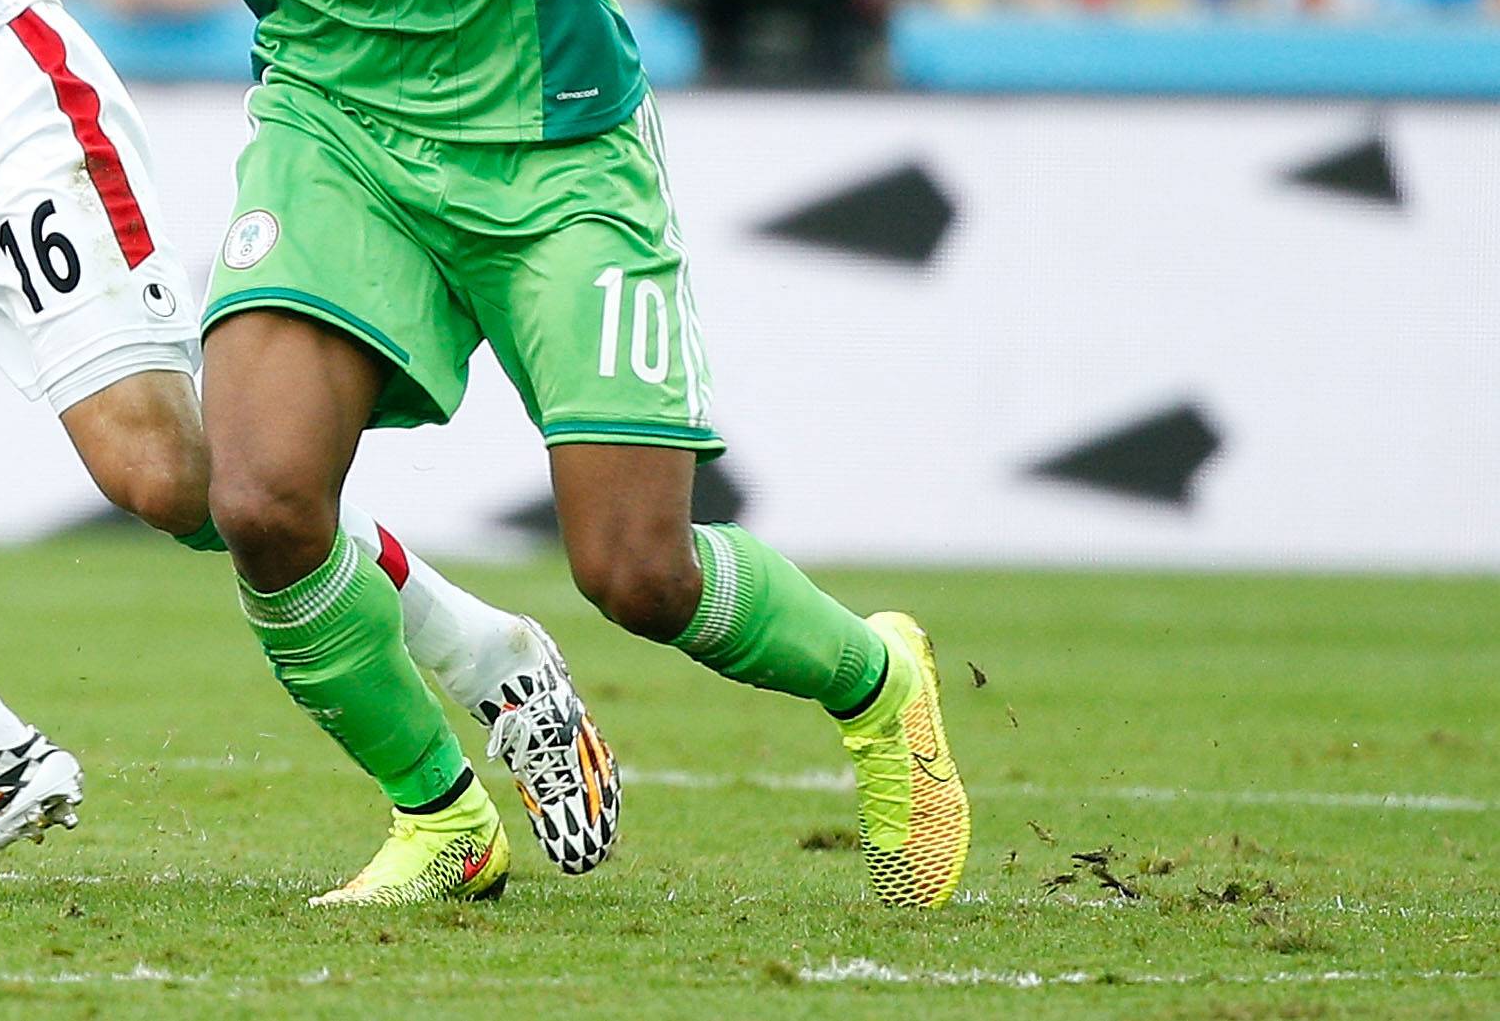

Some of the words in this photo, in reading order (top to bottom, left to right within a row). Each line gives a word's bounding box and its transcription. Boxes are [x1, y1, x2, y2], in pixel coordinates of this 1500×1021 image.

[556, 87, 599, 101] climacool
[0, 198, 81, 314] 16
[593, 266, 670, 385] 10
